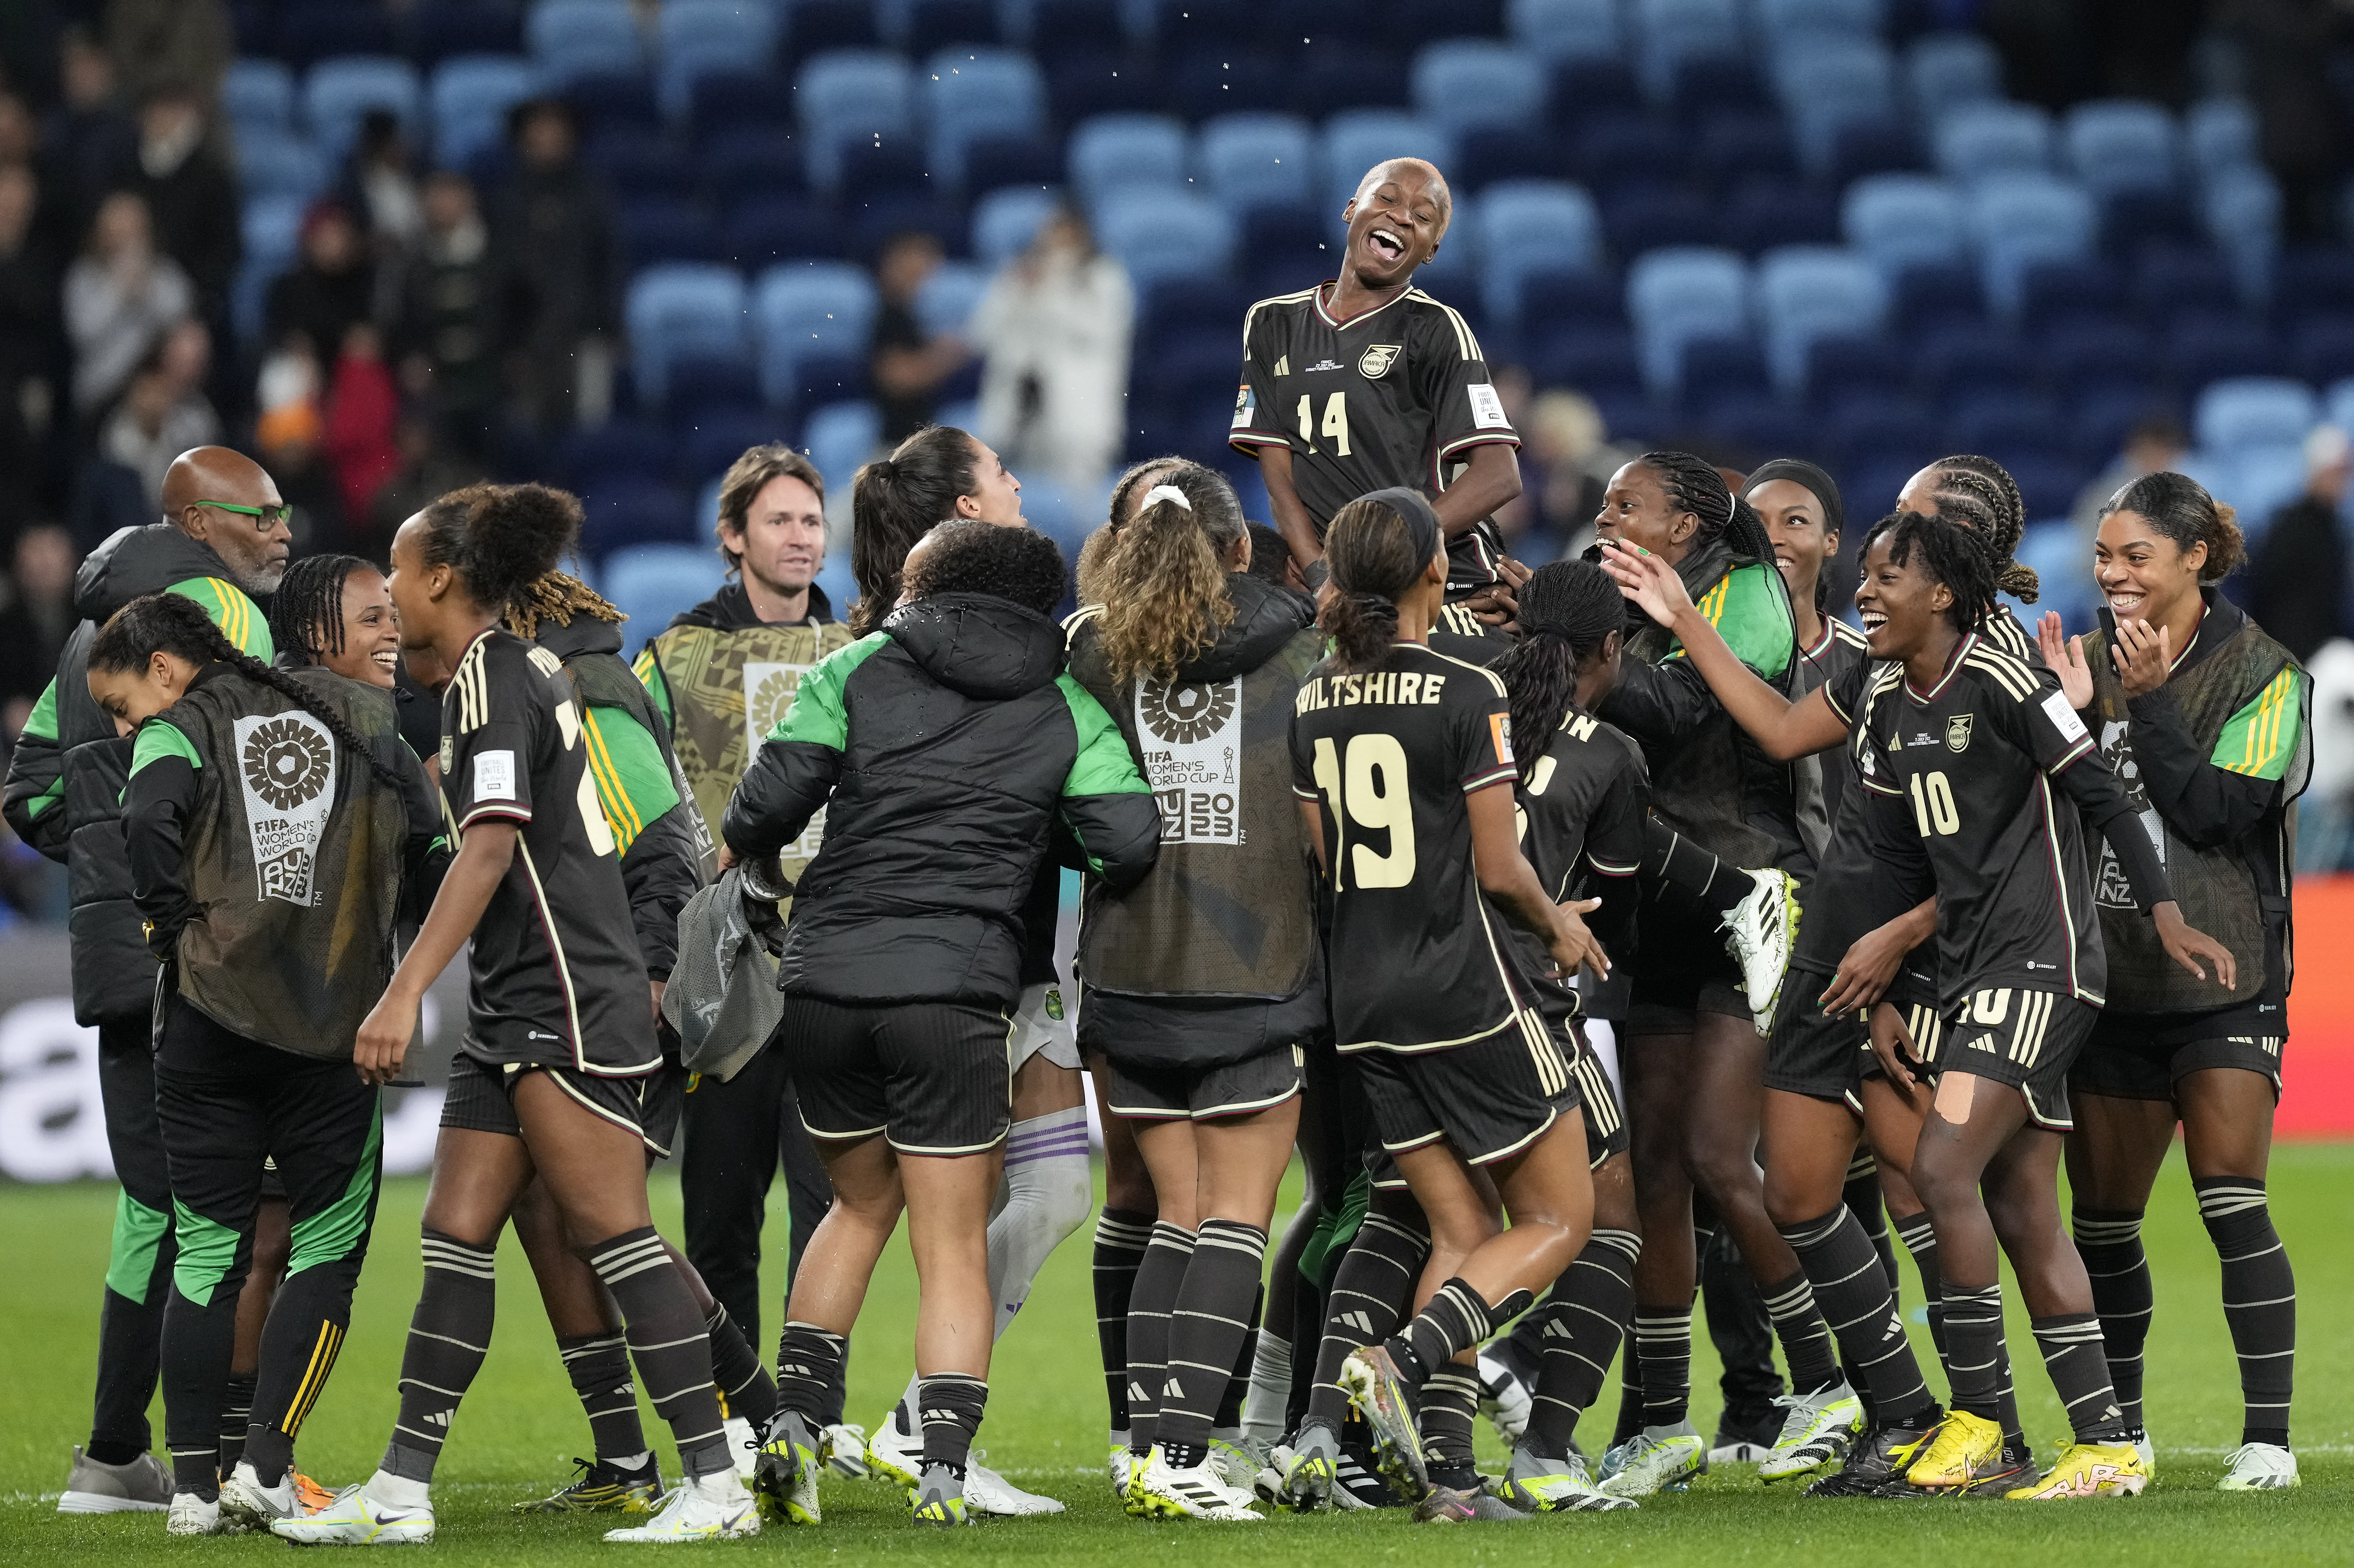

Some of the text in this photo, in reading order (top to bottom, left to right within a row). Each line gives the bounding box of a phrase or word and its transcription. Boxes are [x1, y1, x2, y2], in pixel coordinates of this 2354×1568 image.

[1297, 392, 1351, 456] 14
[1295, 672, 1446, 718] WILTSHIRE
[481, 766, 505, 775] UNITES
[1190, 773, 1218, 783] CUP
[1191, 793, 1234, 814] 20
[1312, 734, 1416, 892] 19
[1910, 771, 1960, 837] 10
[254, 818, 289, 834] FIFA
[257, 820, 314, 846] WOMEN'S
[1191, 815, 1233, 837] 23
[259, 833, 305, 857] WORLD
[2100, 880, 2131, 902] NZ
[1911, 972, 1931, 982] AEROREADY
[1657, 1452, 1674, 1462] PREDATOR
